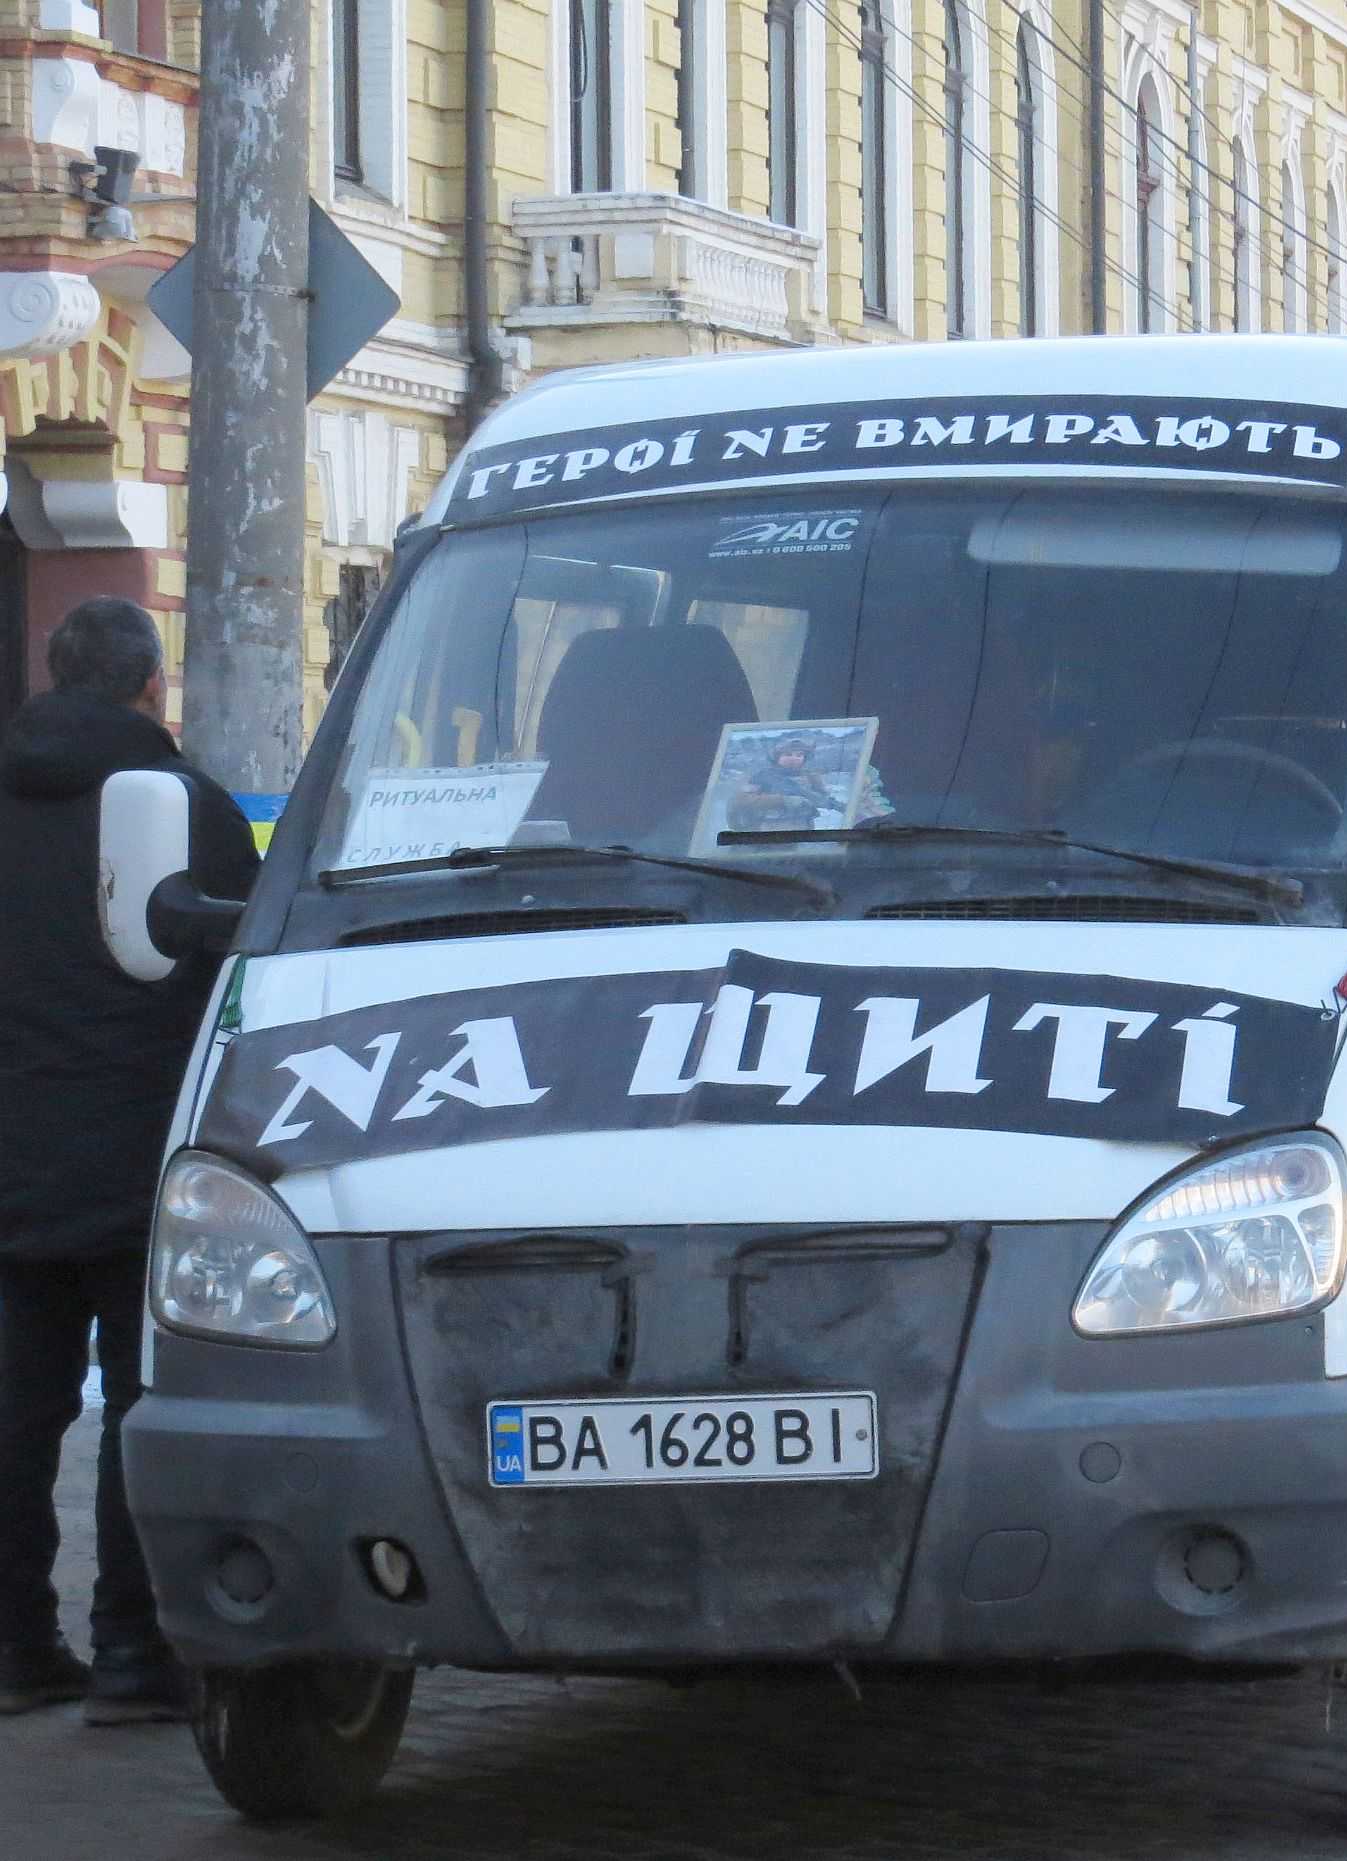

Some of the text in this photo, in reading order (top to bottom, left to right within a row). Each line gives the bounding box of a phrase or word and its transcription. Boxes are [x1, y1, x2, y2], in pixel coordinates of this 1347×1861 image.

[855, 414, 1341, 460] ВМИРАЮТЬ
[777, 517, 860, 542] AIC
[369, 785, 497, 808] РИТУАЛЬНА
[627, 984, 1246, 1118] ЩИТІ
[629, 1411, 755, 1469] 1628
[495, 1455, 522, 1473] UA
